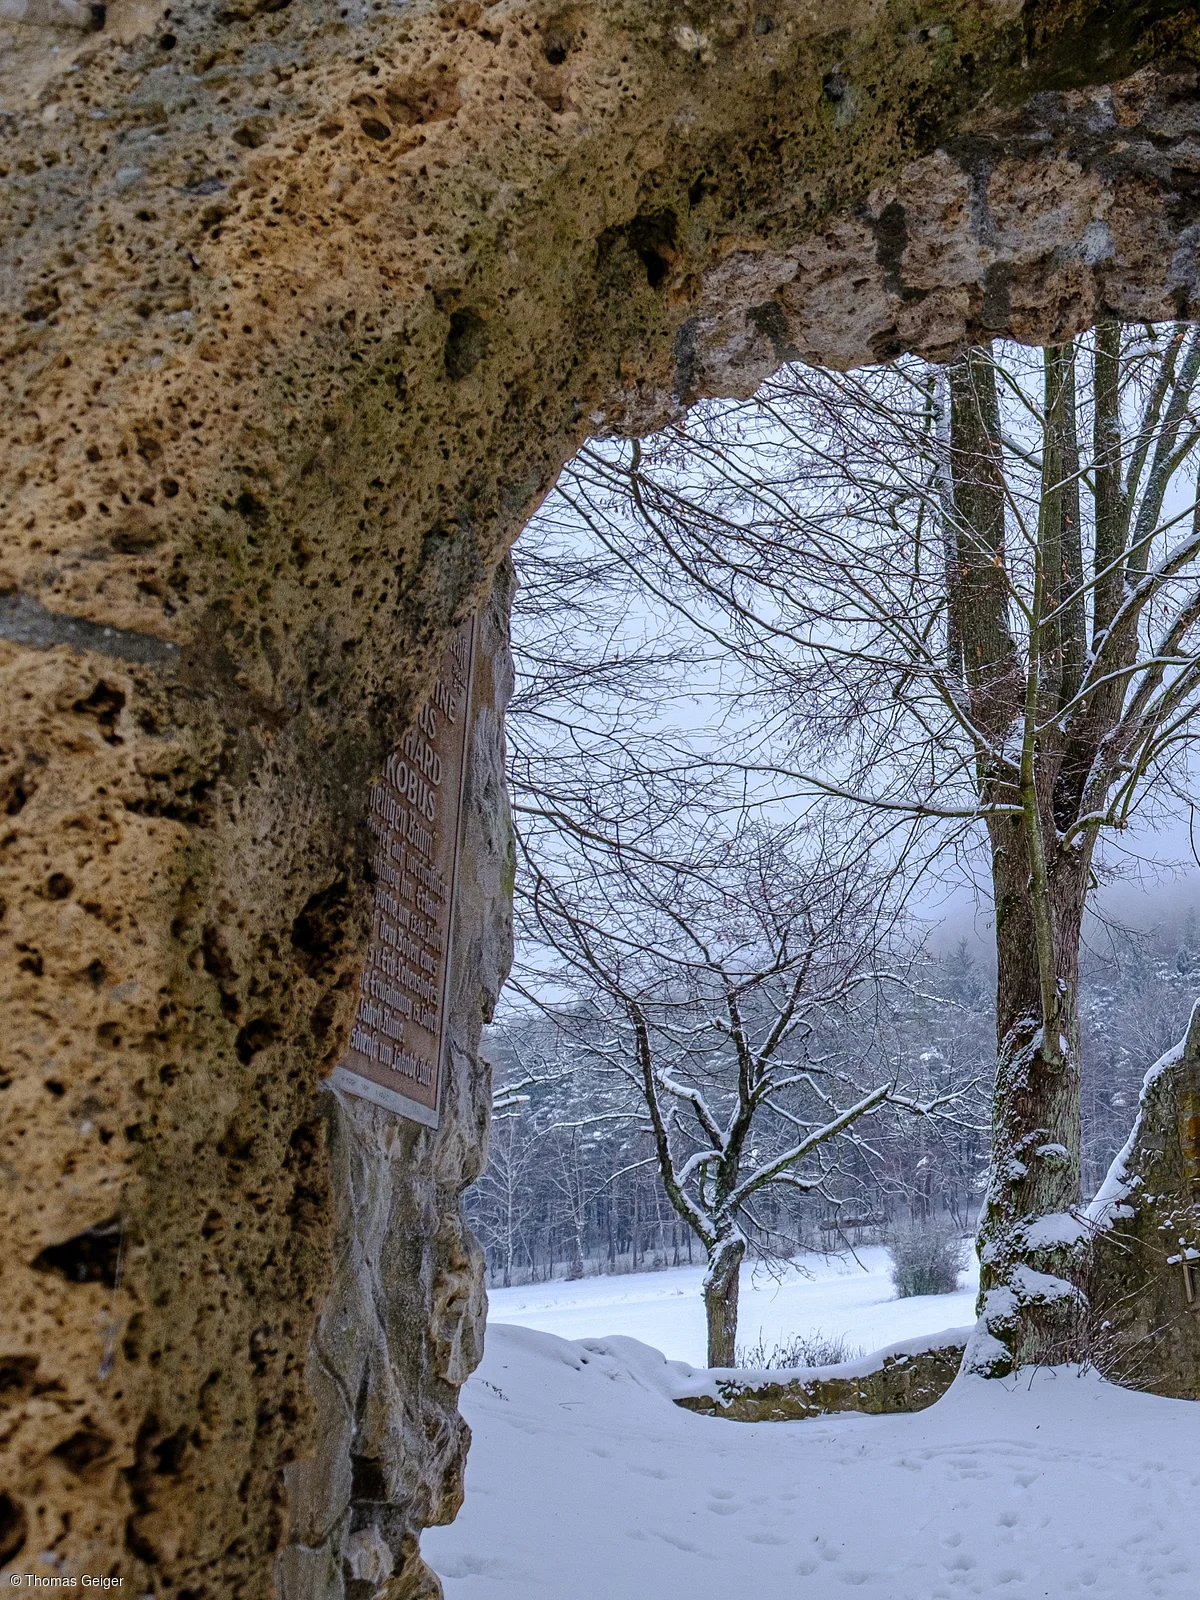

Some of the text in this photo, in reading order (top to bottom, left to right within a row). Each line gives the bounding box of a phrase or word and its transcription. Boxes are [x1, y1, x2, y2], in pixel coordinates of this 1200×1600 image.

[379, 915, 397, 948] dem
[396, 926, 420, 964] Boden
[370, 970, 412, 1020] Erwähnung
[378, 1041, 392, 1066] um
